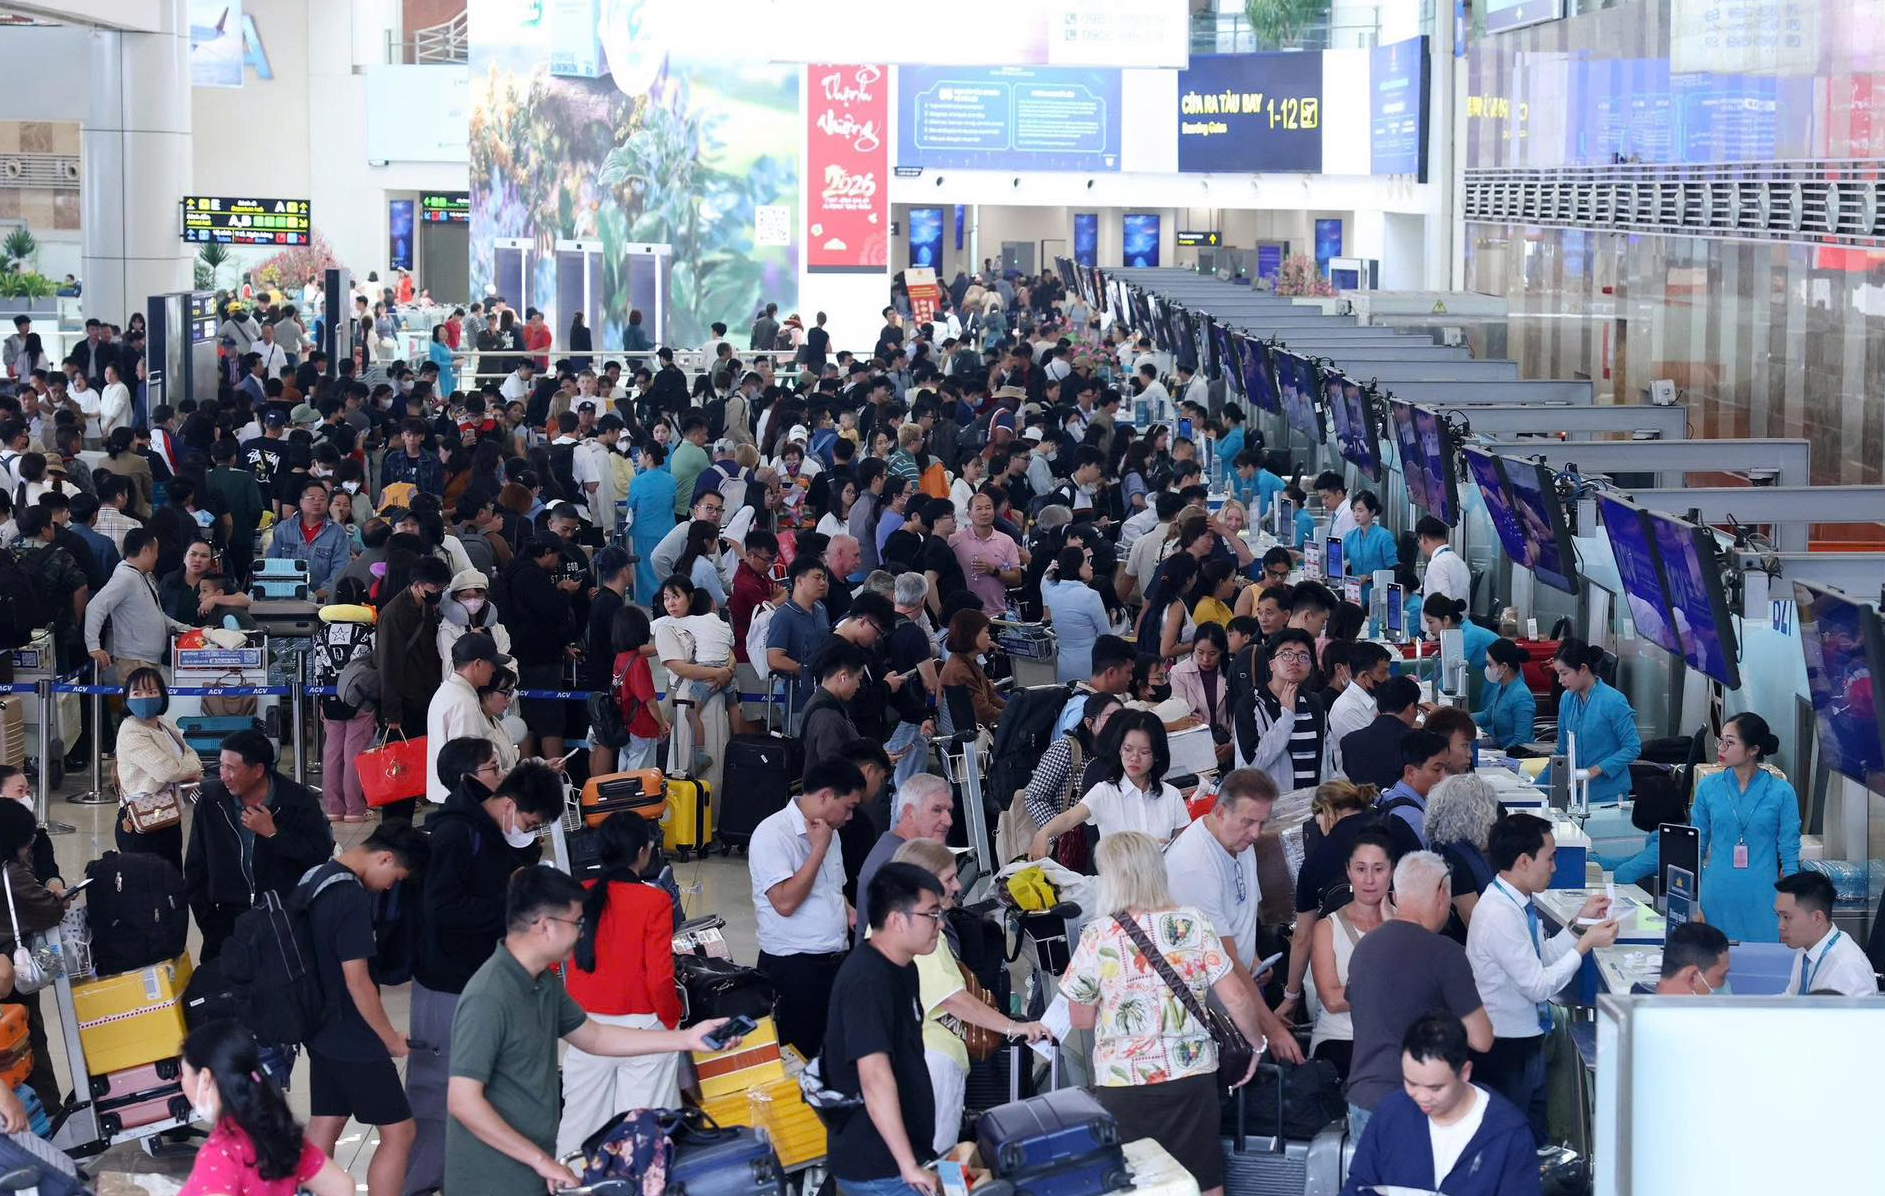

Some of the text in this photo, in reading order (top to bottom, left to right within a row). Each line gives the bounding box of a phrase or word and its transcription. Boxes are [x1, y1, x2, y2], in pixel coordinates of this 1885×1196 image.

[1203, 94, 1219, 114] RA
[1219, 89, 1240, 114] TÀU
[1242, 93, 1263, 114] BAY
[1267, 98, 1298, 129] 1-12
[1182, 121, 1228, 136] Boarding Gates
[821, 163, 876, 198] 2026
[274, 200, 286, 212] A
